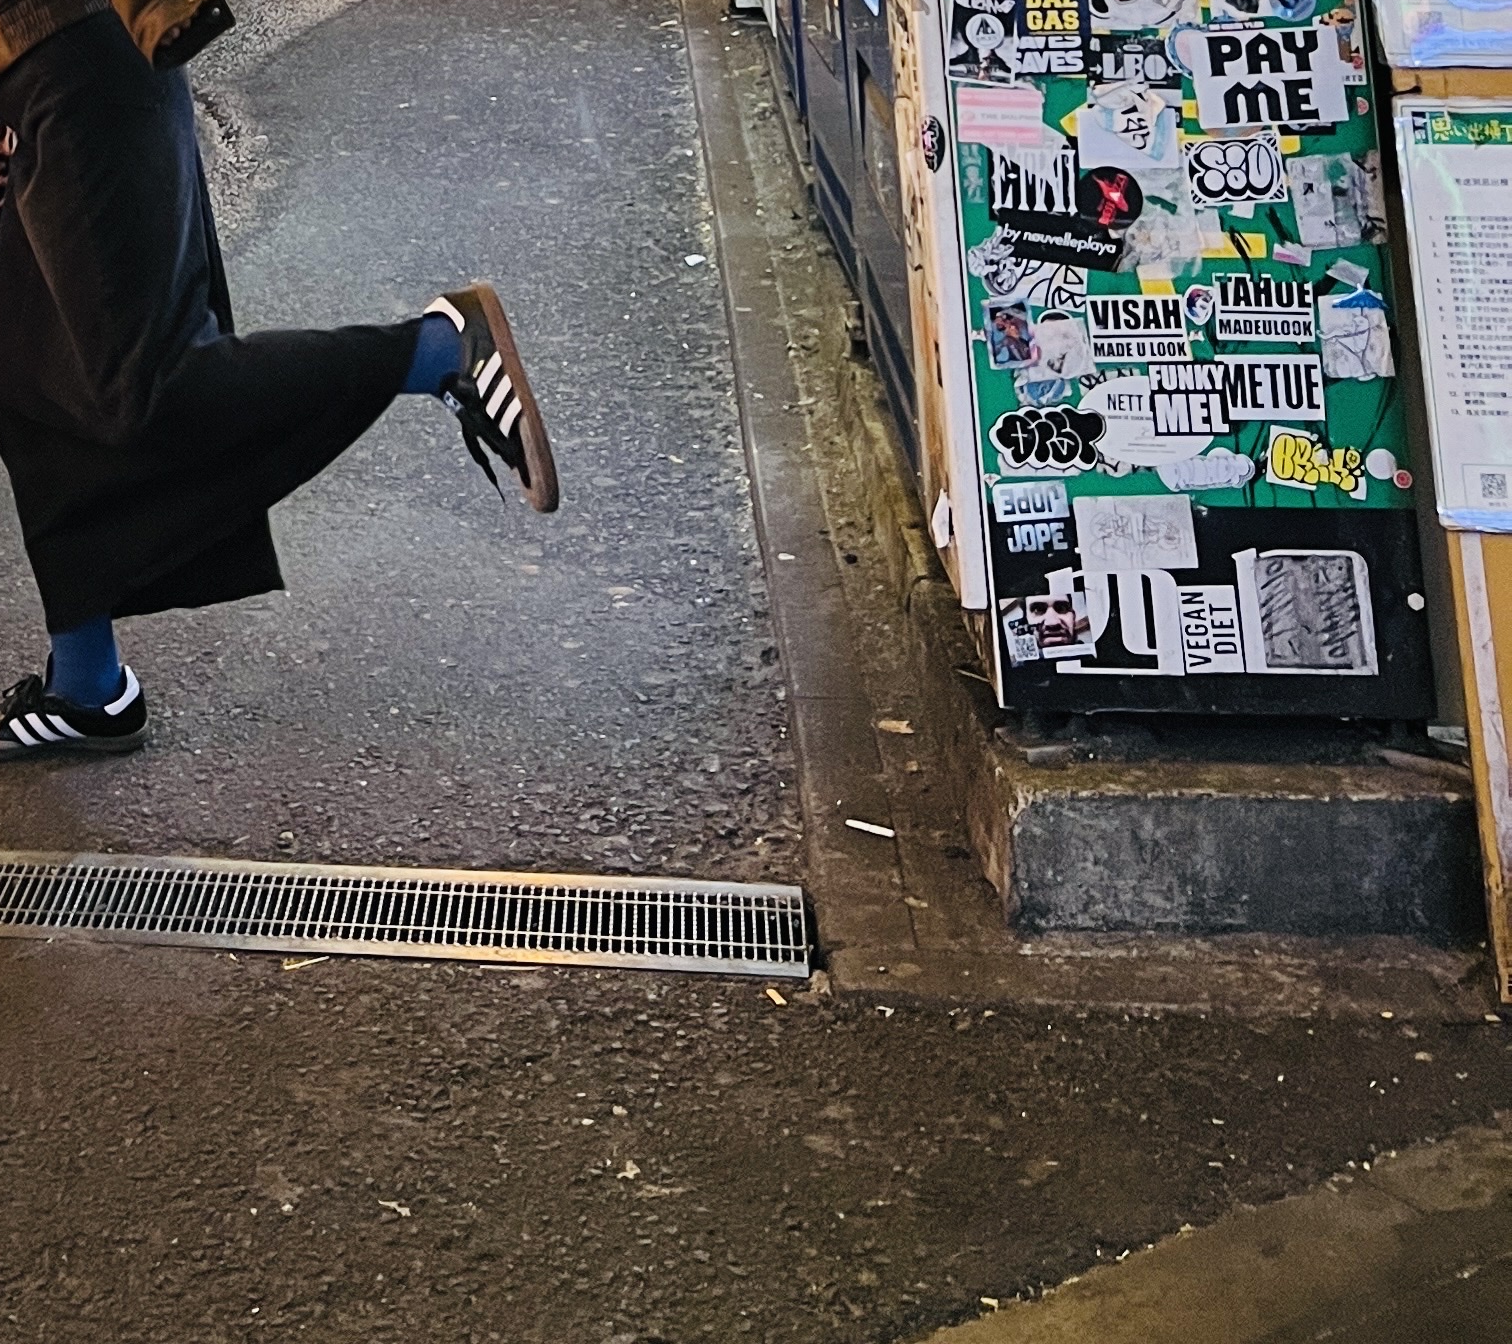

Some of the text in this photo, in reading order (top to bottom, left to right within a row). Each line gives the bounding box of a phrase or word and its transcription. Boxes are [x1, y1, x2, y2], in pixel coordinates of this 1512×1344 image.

[1026, 10, 1081, 31] GAS
[1205, 29, 1319, 77] PAY
[1223, 78, 1321, 124] ME
[1003, 223, 1021, 243] by
[1217, 277, 1314, 309] TAHUE
[1092, 299, 1183, 332] VISAH
[1093, 341, 1187, 359] MADE U LOOK
[1149, 363, 1225, 391] FUNKY
[1223, 363, 1321, 411] METUE
[1107, 393, 1144, 412] NETT
[1154, 393, 1230, 433] MEL
[1007, 522, 1068, 553] JOPE
[1181, 590, 1204, 669] VEGAN
[1214, 602, 1235, 655] DIET
